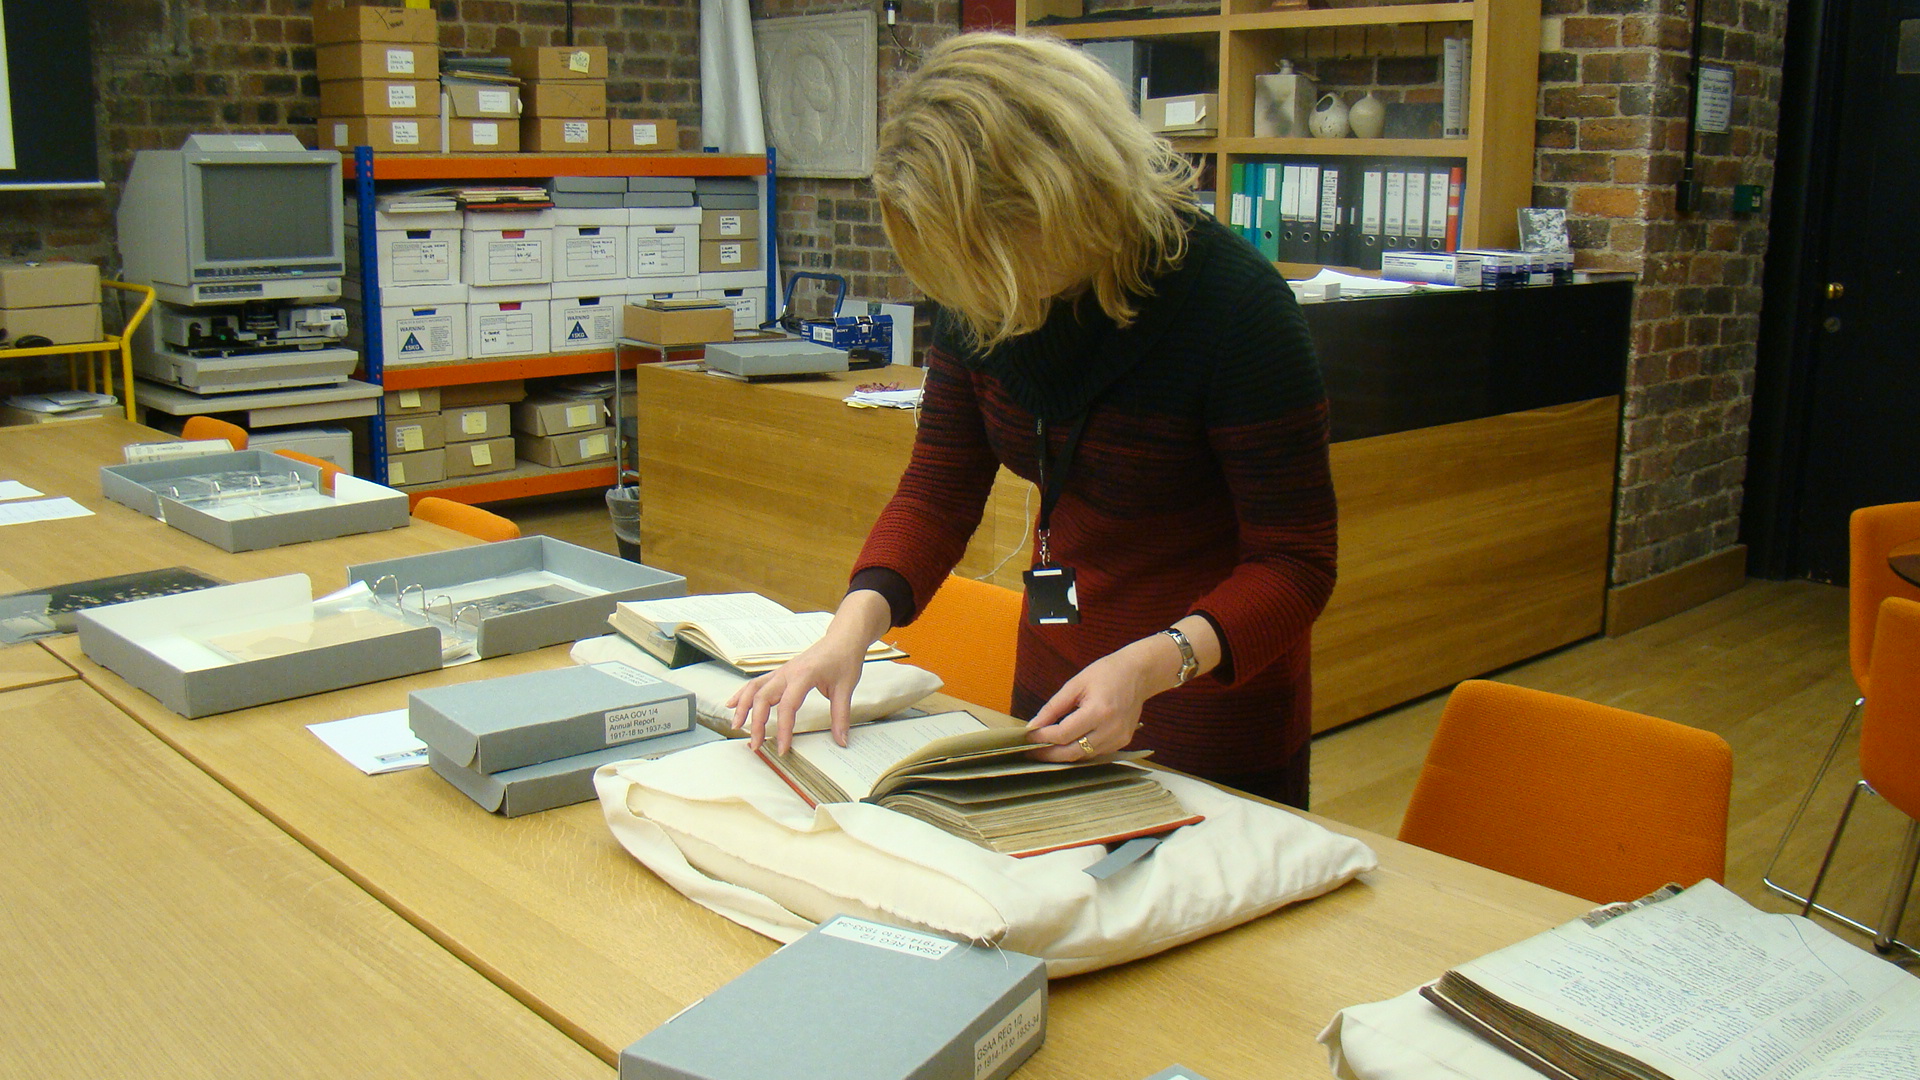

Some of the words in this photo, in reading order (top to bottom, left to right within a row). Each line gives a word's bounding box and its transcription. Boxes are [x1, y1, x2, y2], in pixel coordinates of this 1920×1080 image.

[608, 713, 630, 723] GSAA
[630, 710, 647, 719] GOV
[610, 720, 632, 731] Annual
[634, 717, 656, 727] Report
[610, 728, 636, 740] 1917-18
[646, 723, 671, 733] 1937-38
[836, 920, 878, 934] 1933-34
[879, 938, 906, 948] REG
[894, 934, 935, 947] 1914-15
[908, 944, 941, 955] GSAA
[976, 1037, 996, 1060] GSAA
[998, 1023, 1012, 1043] REG
[1014, 1013, 1023, 1028] 1/2
[976, 1064, 982, 1076] P
[984, 1044, 1009, 1069] 1914-15
[1009, 1037, 1015, 1048] to
[1017, 1013, 1039, 1040] 1933-34
